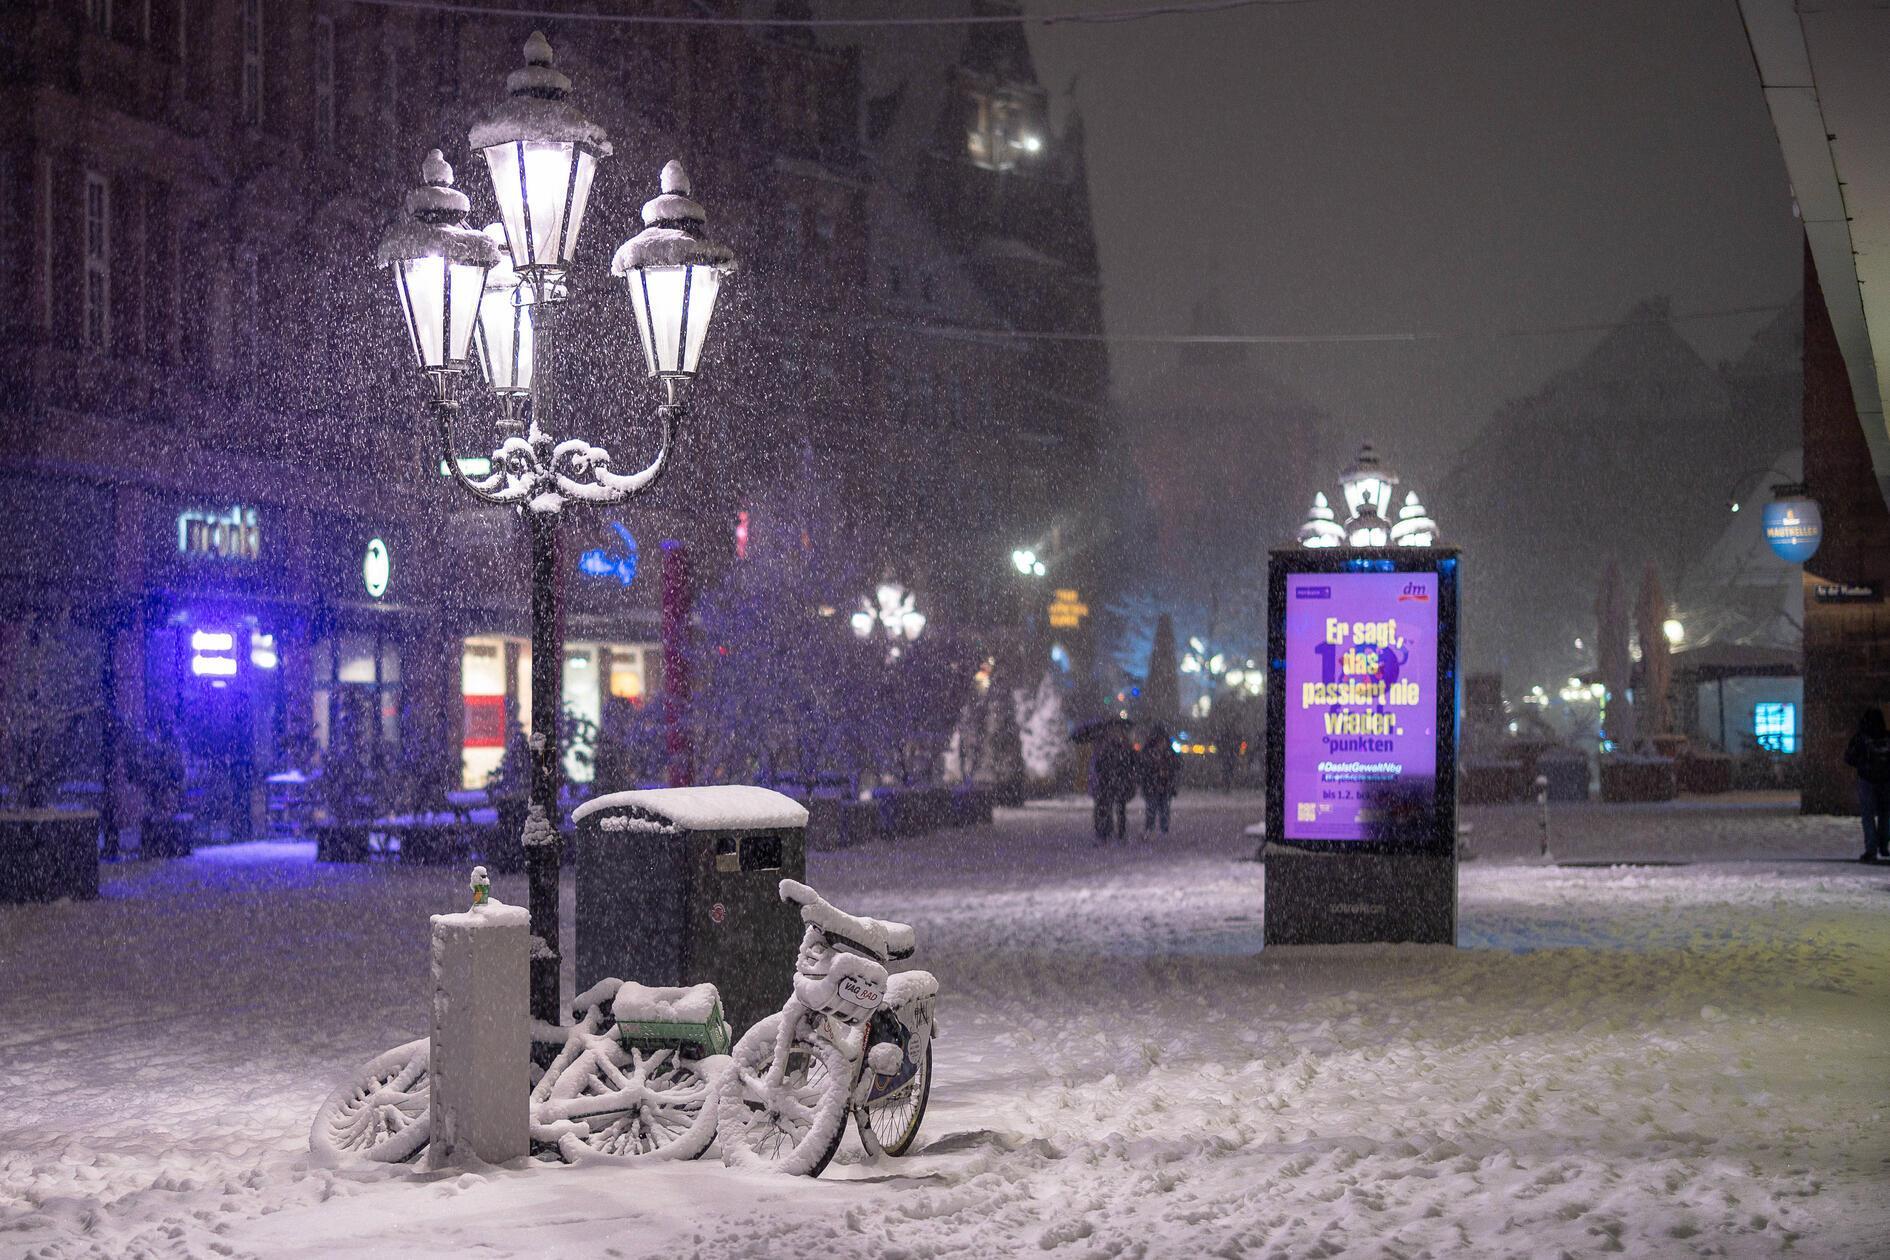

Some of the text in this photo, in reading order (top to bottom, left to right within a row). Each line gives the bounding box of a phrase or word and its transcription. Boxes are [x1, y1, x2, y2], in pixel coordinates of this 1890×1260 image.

[1403, 581, 1426, 595] dm
[1326, 617, 1404, 649] Er sagt,
[1342, 647, 1379, 675] das
[1302, 678, 1420, 709] passiert nie
[1324, 708, 1404, 735] wieder.
[844, 981, 878, 1002] VAG RAD
